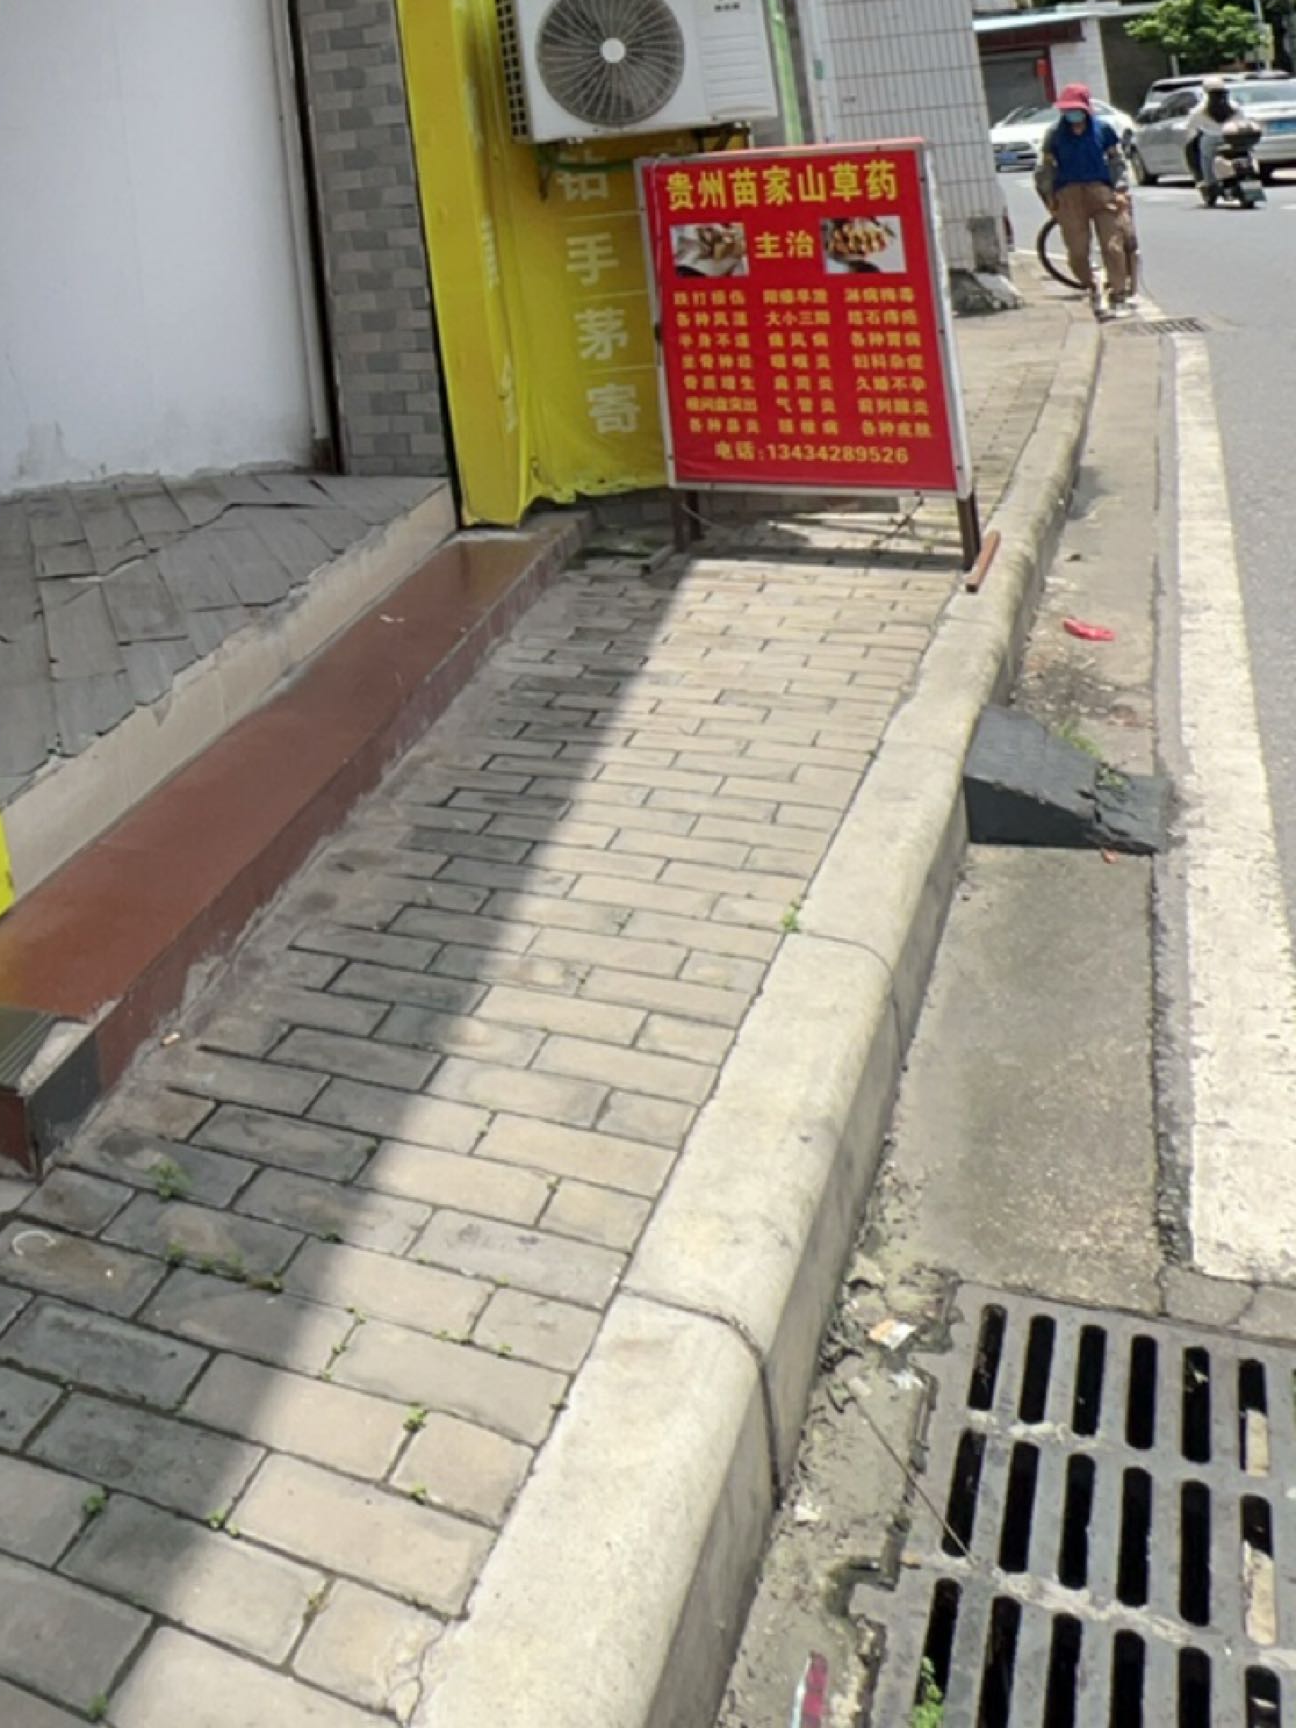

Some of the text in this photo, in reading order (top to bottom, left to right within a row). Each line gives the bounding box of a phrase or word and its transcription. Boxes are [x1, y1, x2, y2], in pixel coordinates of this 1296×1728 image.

[665, 159, 899, 211] 贵州苗家山草药
[754, 229, 815, 259] 主治
